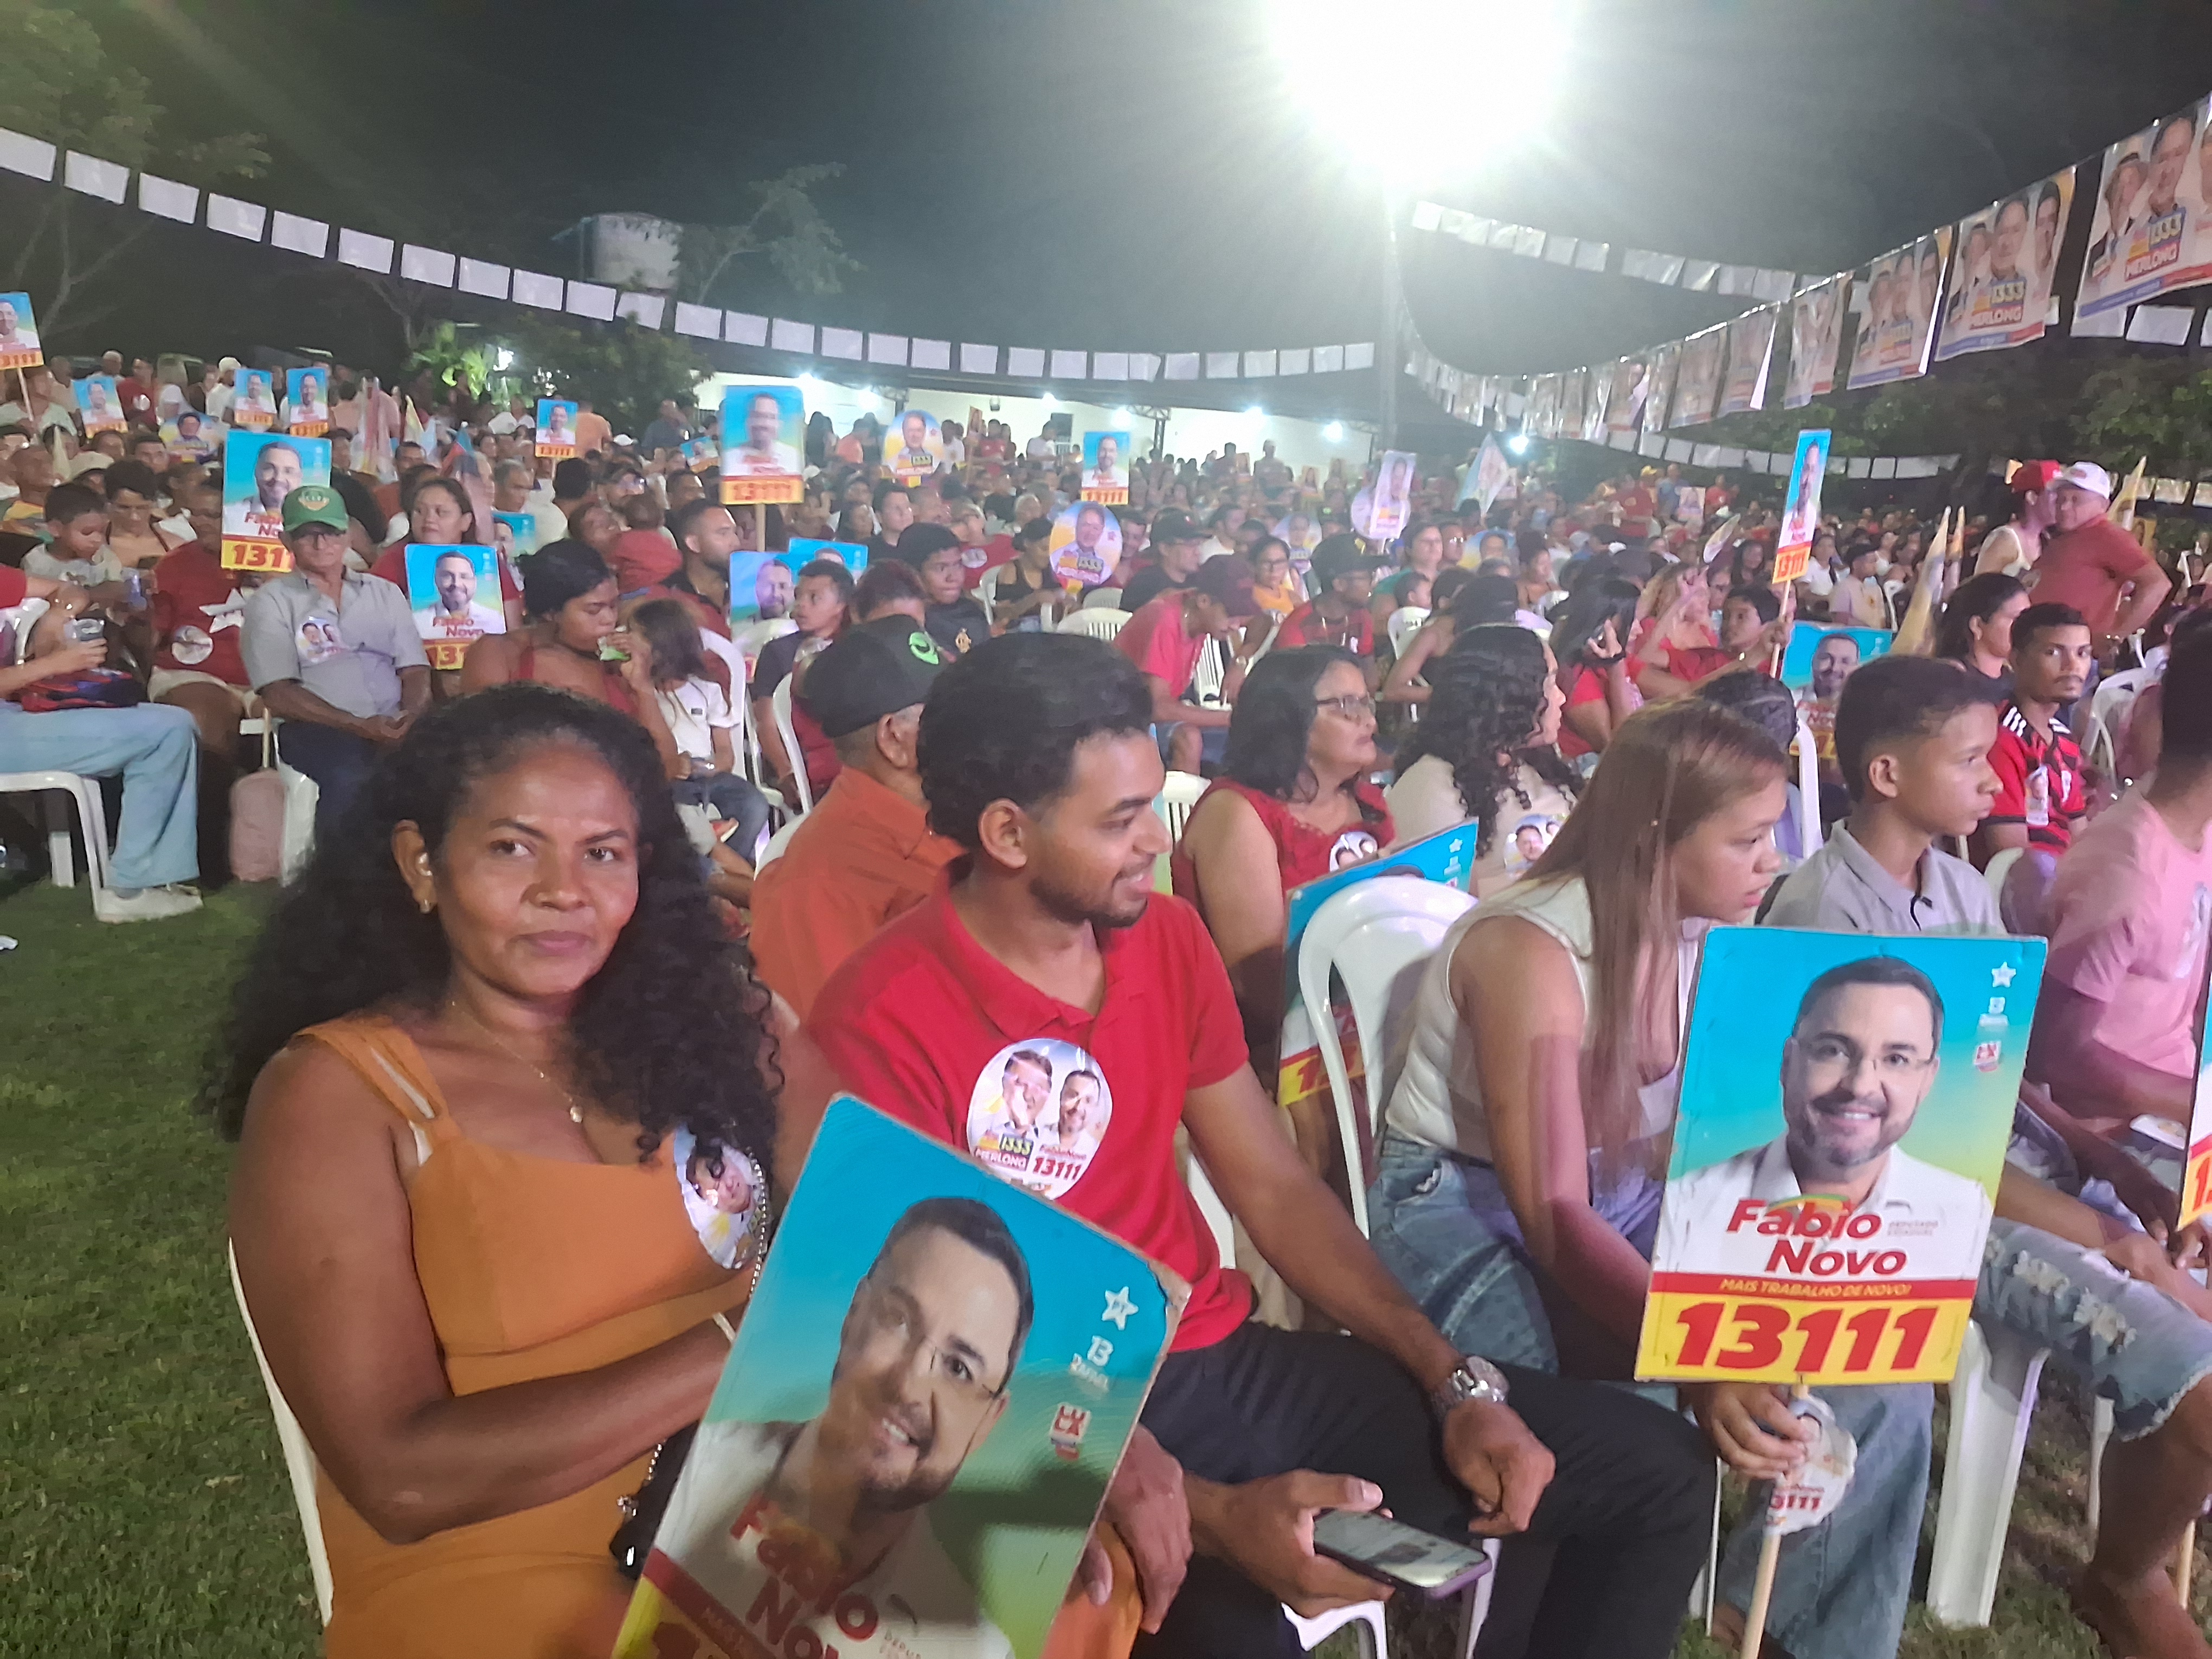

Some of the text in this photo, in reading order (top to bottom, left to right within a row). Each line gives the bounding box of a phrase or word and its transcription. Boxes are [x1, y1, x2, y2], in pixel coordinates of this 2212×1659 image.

[1032, 1156, 1082, 1180] 13111
[1726, 1198, 1882, 1240] Fabio
[1765, 1239, 1907, 1276] Novo
[1720, 1278, 1758, 1293] MAIS
[1761, 1280, 1842, 1296] TRABALHO
[1676, 1301, 1939, 1373] 13111
